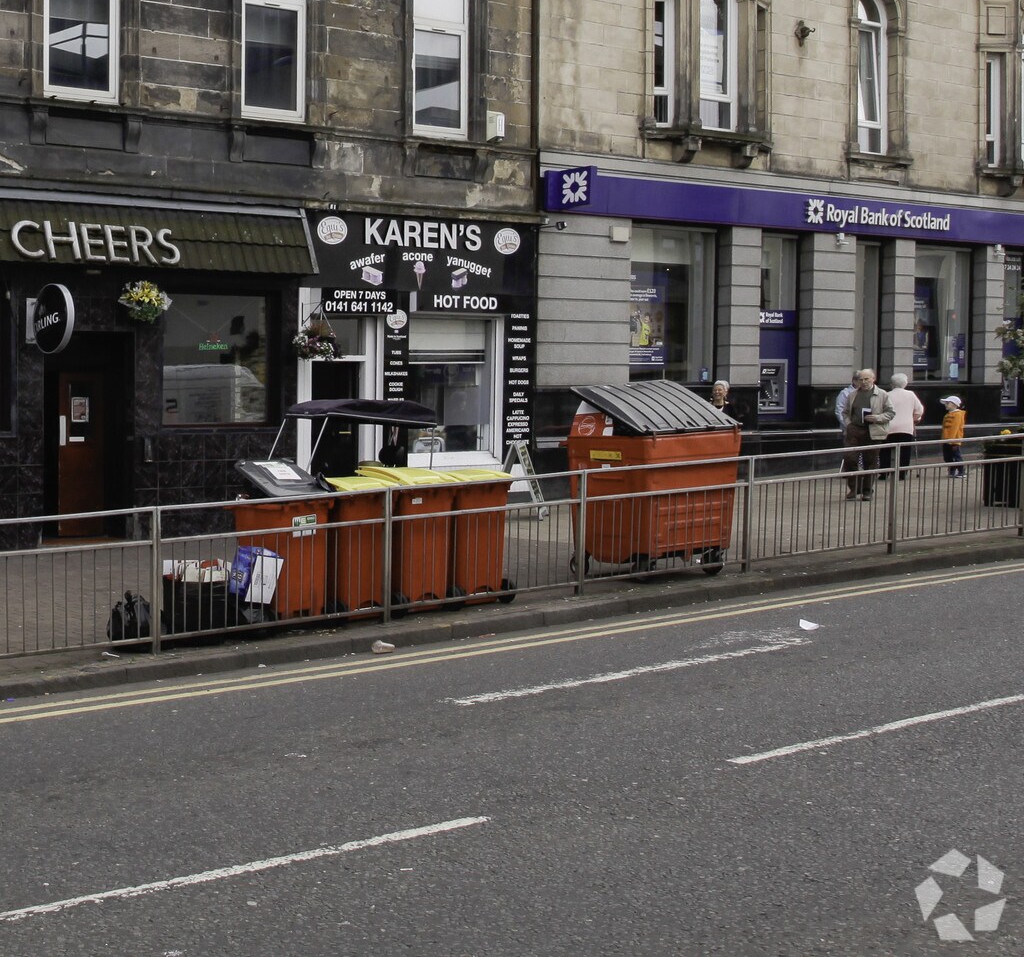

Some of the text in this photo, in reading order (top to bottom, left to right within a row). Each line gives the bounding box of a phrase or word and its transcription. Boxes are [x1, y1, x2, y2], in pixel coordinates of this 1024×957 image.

[826, 204, 950, 231] Royal Bank of Scotland
[365, 218, 482, 251] KAREN'S
[11, 220, 181, 265] CHEERS
[334, 290, 386, 299] OPEN 7 DAYS
[325, 301, 393, 312] 0141 641 1142
[433, 295, 498, 309] HOT FOOD
[199, 343, 228, 351] Heineken
